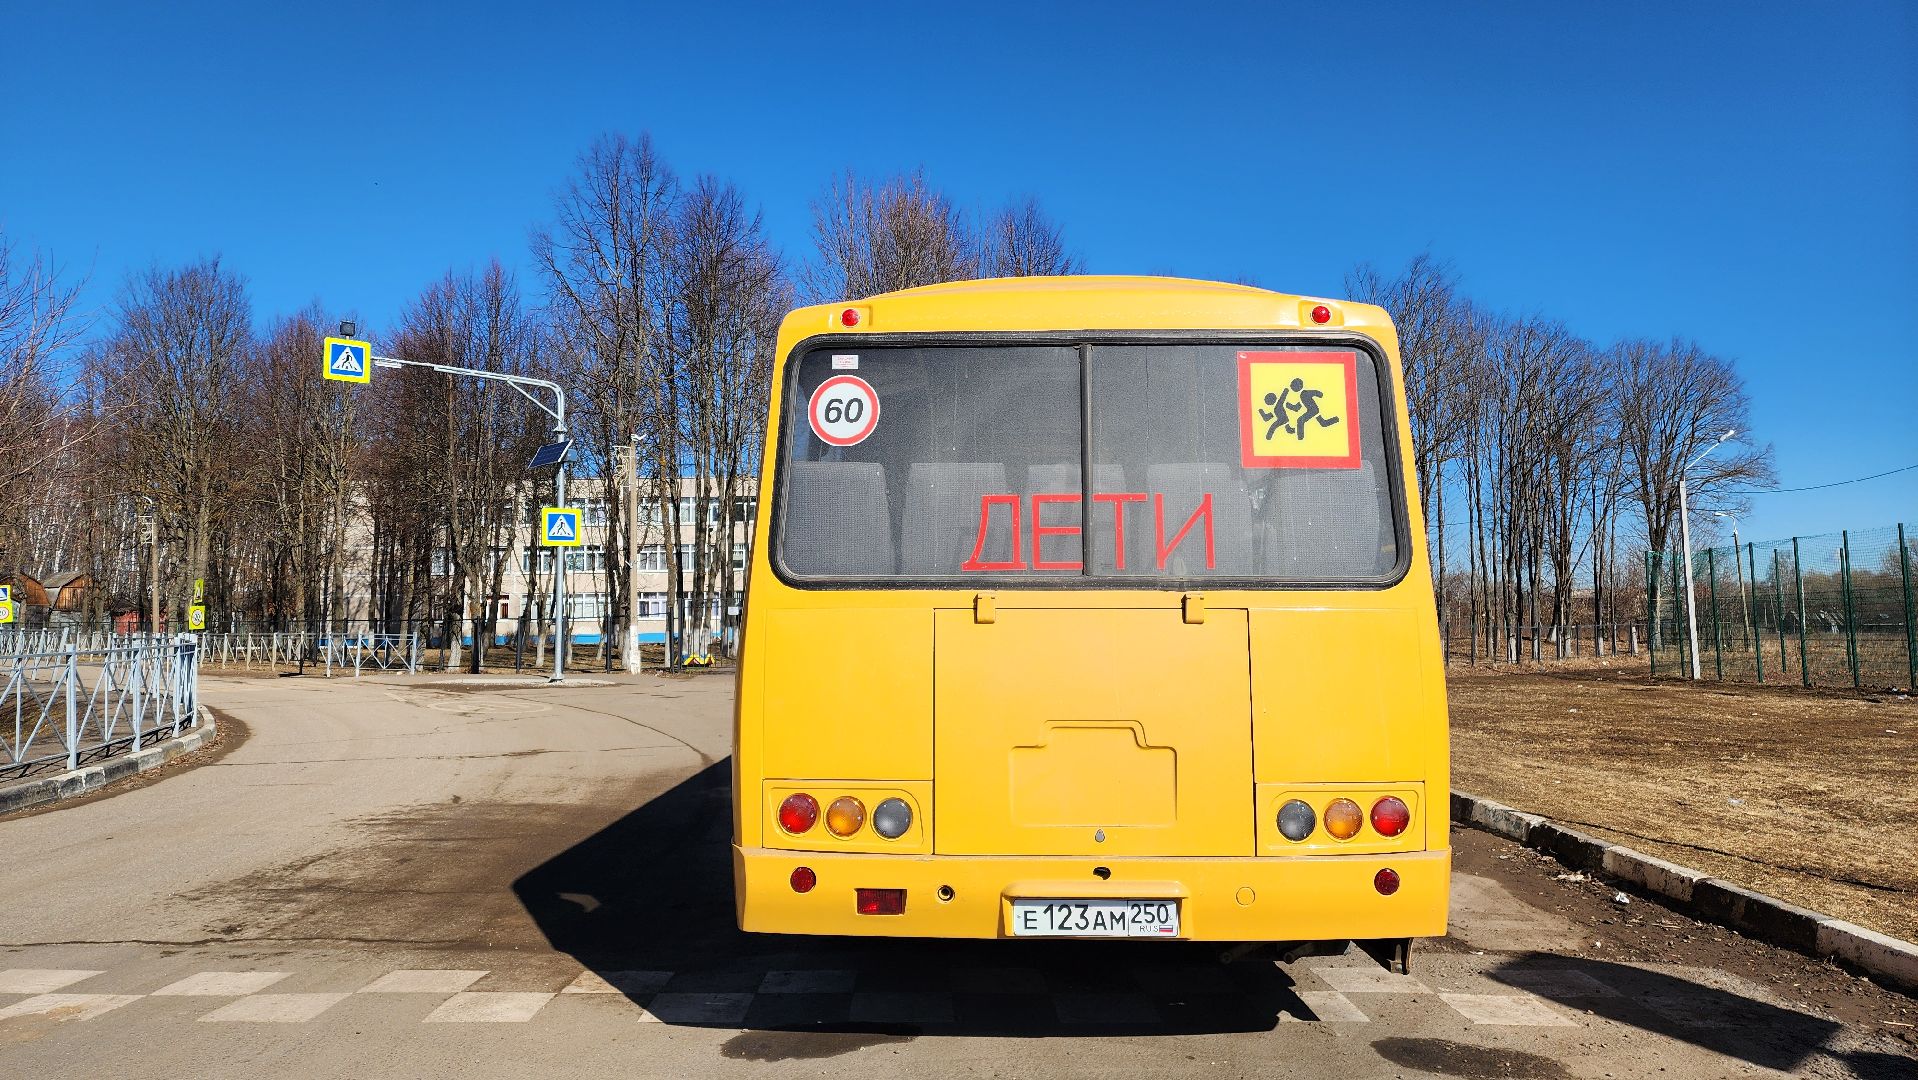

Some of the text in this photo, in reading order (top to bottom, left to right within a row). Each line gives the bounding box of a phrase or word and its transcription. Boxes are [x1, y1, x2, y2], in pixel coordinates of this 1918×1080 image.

[824, 397, 864, 424] 60
[961, 493, 1215, 571] ДЕТИ
[1131, 903, 1169, 924] 250
[1139, 925, 1159, 933] RUS
